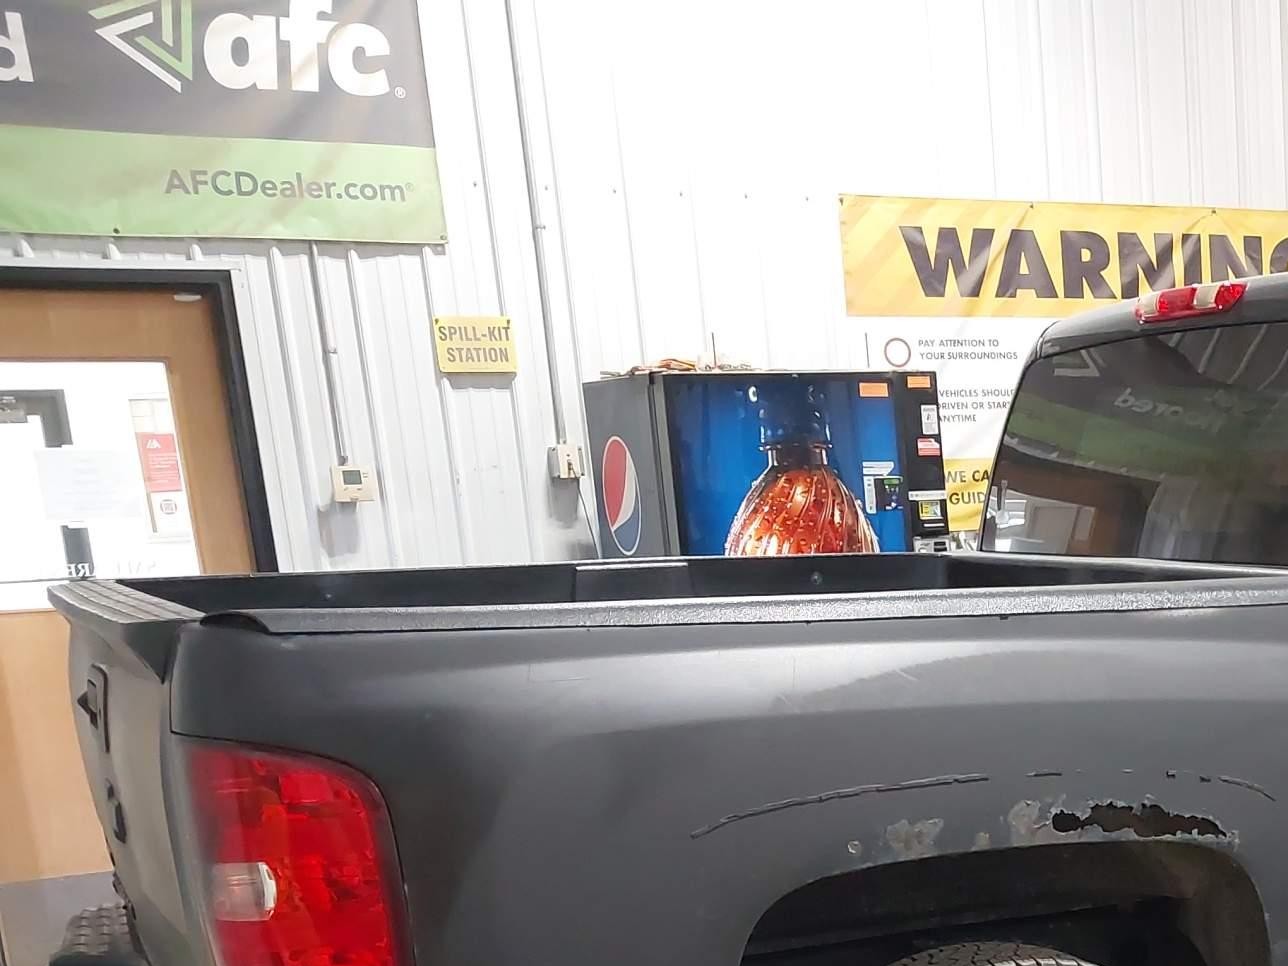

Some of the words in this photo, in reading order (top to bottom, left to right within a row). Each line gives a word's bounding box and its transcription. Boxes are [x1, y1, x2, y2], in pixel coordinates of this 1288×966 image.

[438, 326, 511, 342] SPILL-KIT
[918, 338, 935, 348] PAY
[939, 338, 985, 348] ATTENTION
[988, 338, 1000, 348] TO
[446, 347, 509, 363] STATION
[919, 351, 945, 361] YOUR
[947, 351, 1018, 361] SURROUNDINGS
[939, 388, 979, 398] VEHICLES
[971, 401, 985, 410] OR
[987, 401, 1010, 410] STAR
[971, 469, 989, 483] CA
[949, 491, 986, 505] GUID
